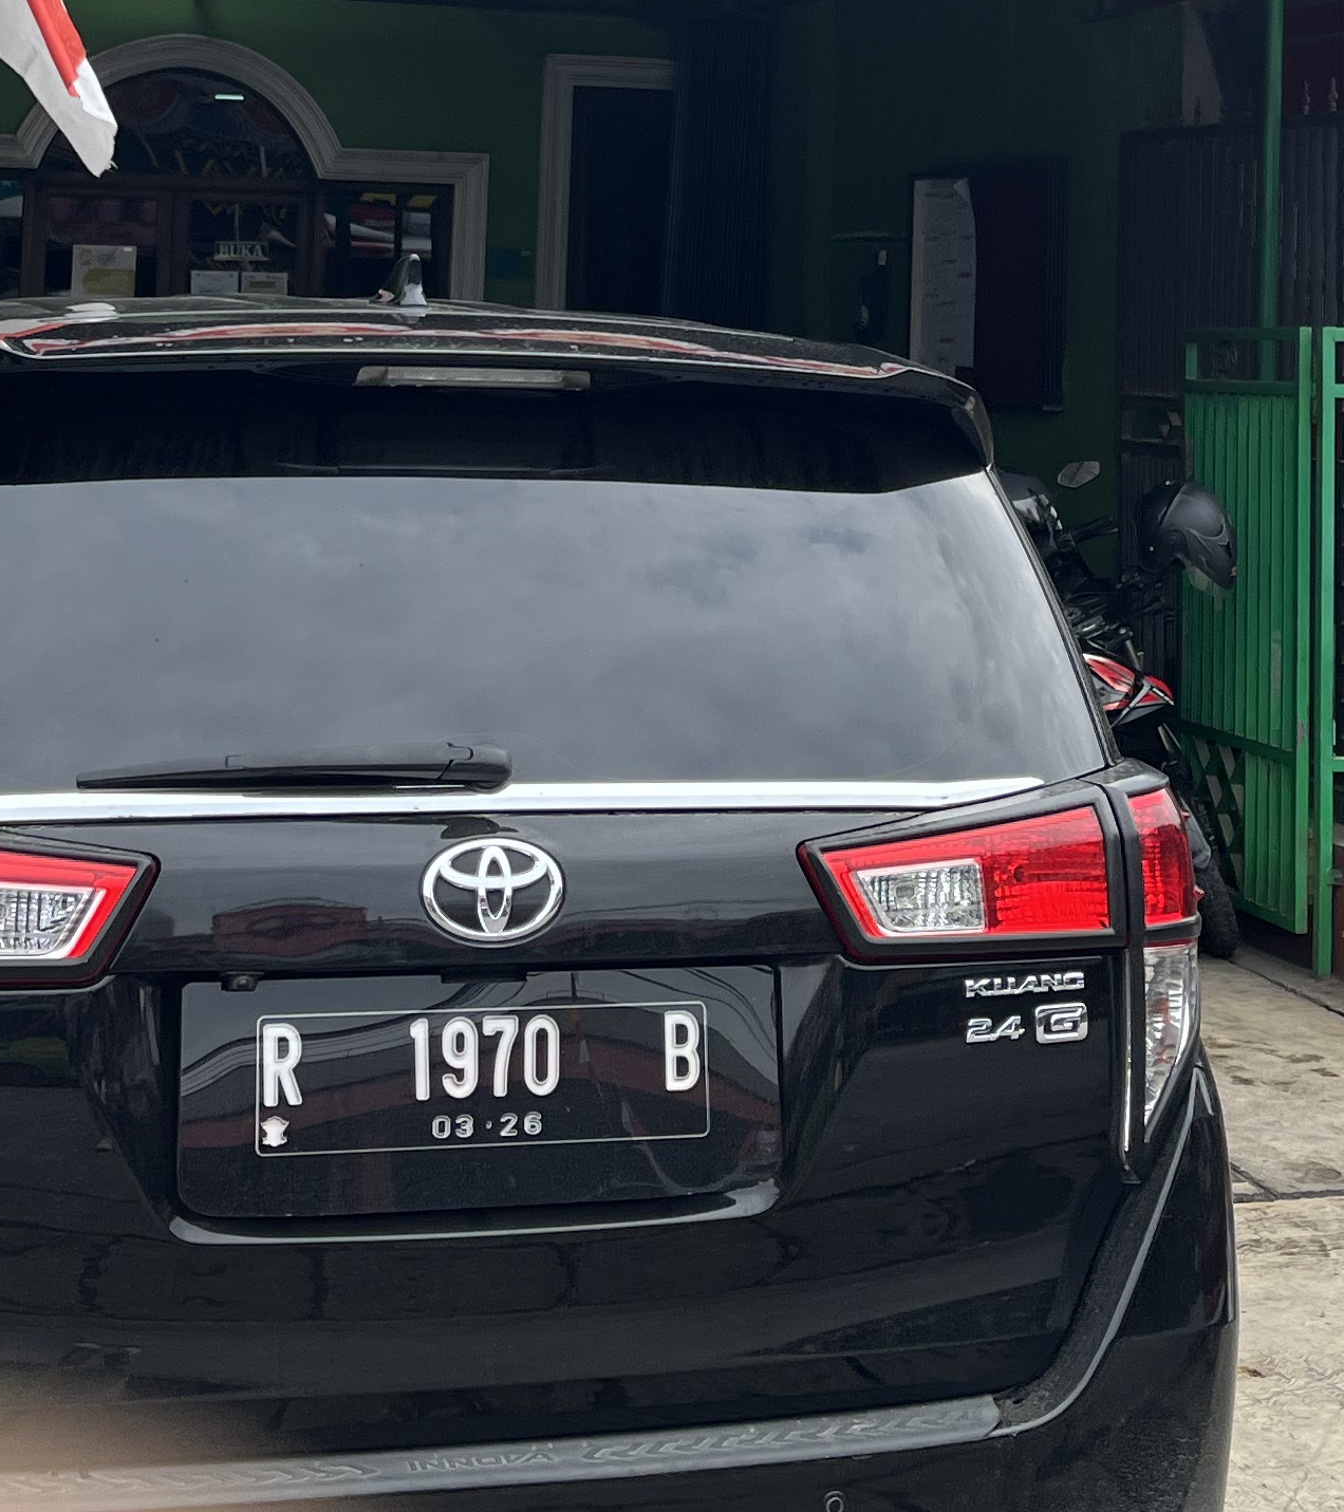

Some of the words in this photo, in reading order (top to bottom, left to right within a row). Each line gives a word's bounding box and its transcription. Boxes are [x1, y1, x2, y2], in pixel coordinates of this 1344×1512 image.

[262, 1022, 303, 1108] R
[409, 1013, 562, 1103] 1970
[663, 1009, 701, 1092] B
